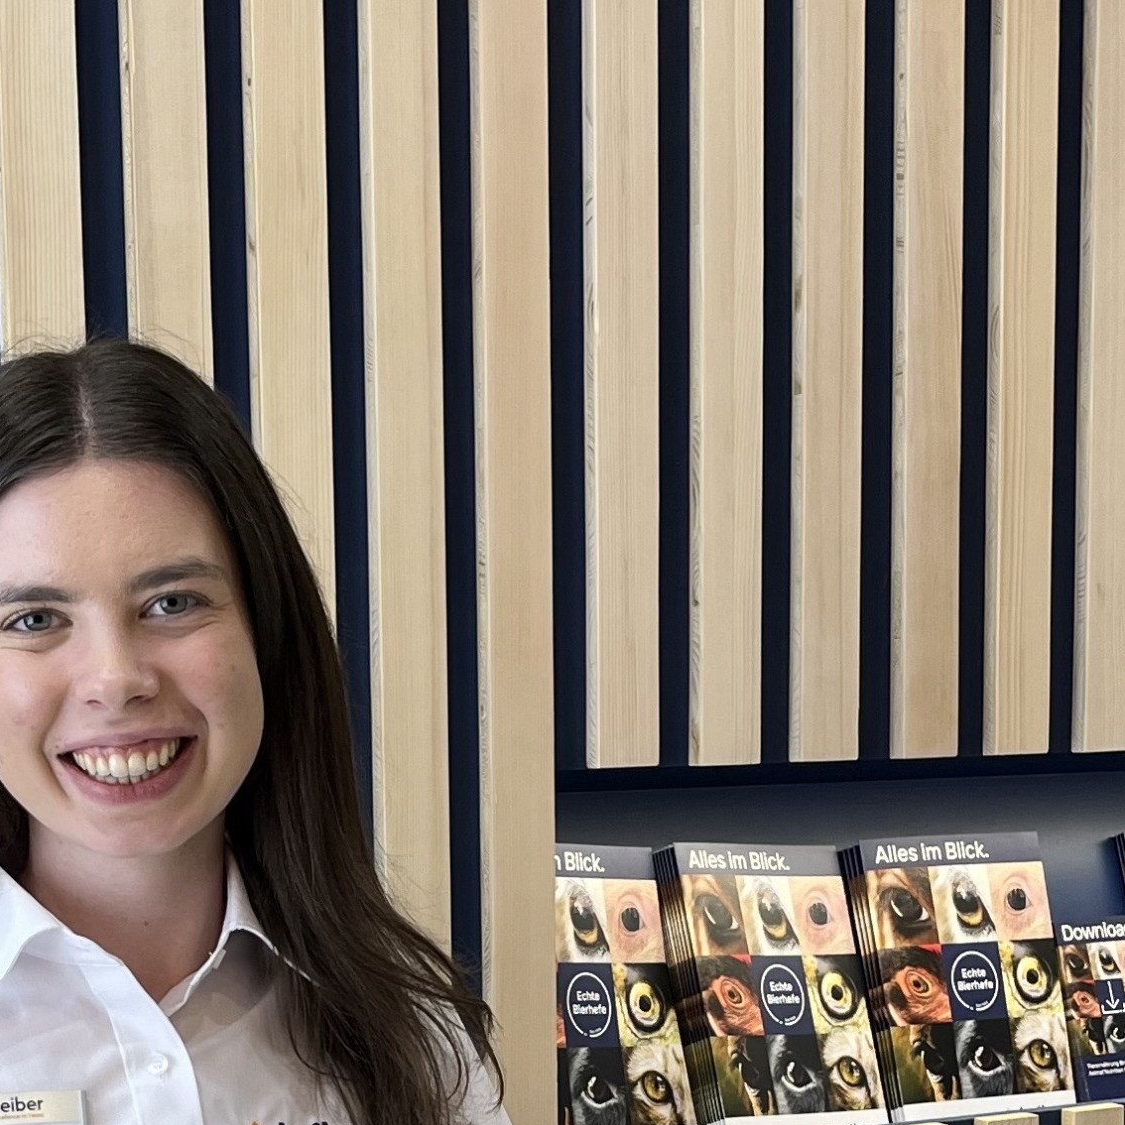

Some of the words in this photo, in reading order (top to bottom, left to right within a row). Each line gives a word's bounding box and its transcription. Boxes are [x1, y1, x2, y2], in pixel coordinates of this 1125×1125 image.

[875, 843, 919, 864] Alles
[920, 842, 942, 861] im
[944, 840, 990, 860] Blick.
[564, 851, 606, 873] Blick.
[688, 850, 726, 869] Alles
[727, 851, 748, 870] im
[750, 851, 791, 871] Blick.
[1060, 921, 1125, 942] Downloa
[961, 967, 987, 979] Echte
[769, 981, 793, 992] Echte
[957, 979, 994, 991] Bierhefe
[576, 990, 601, 1001] Echte
[766, 993, 800, 1005] Bierhefe
[572, 1003, 607, 1015] Bierhefe
